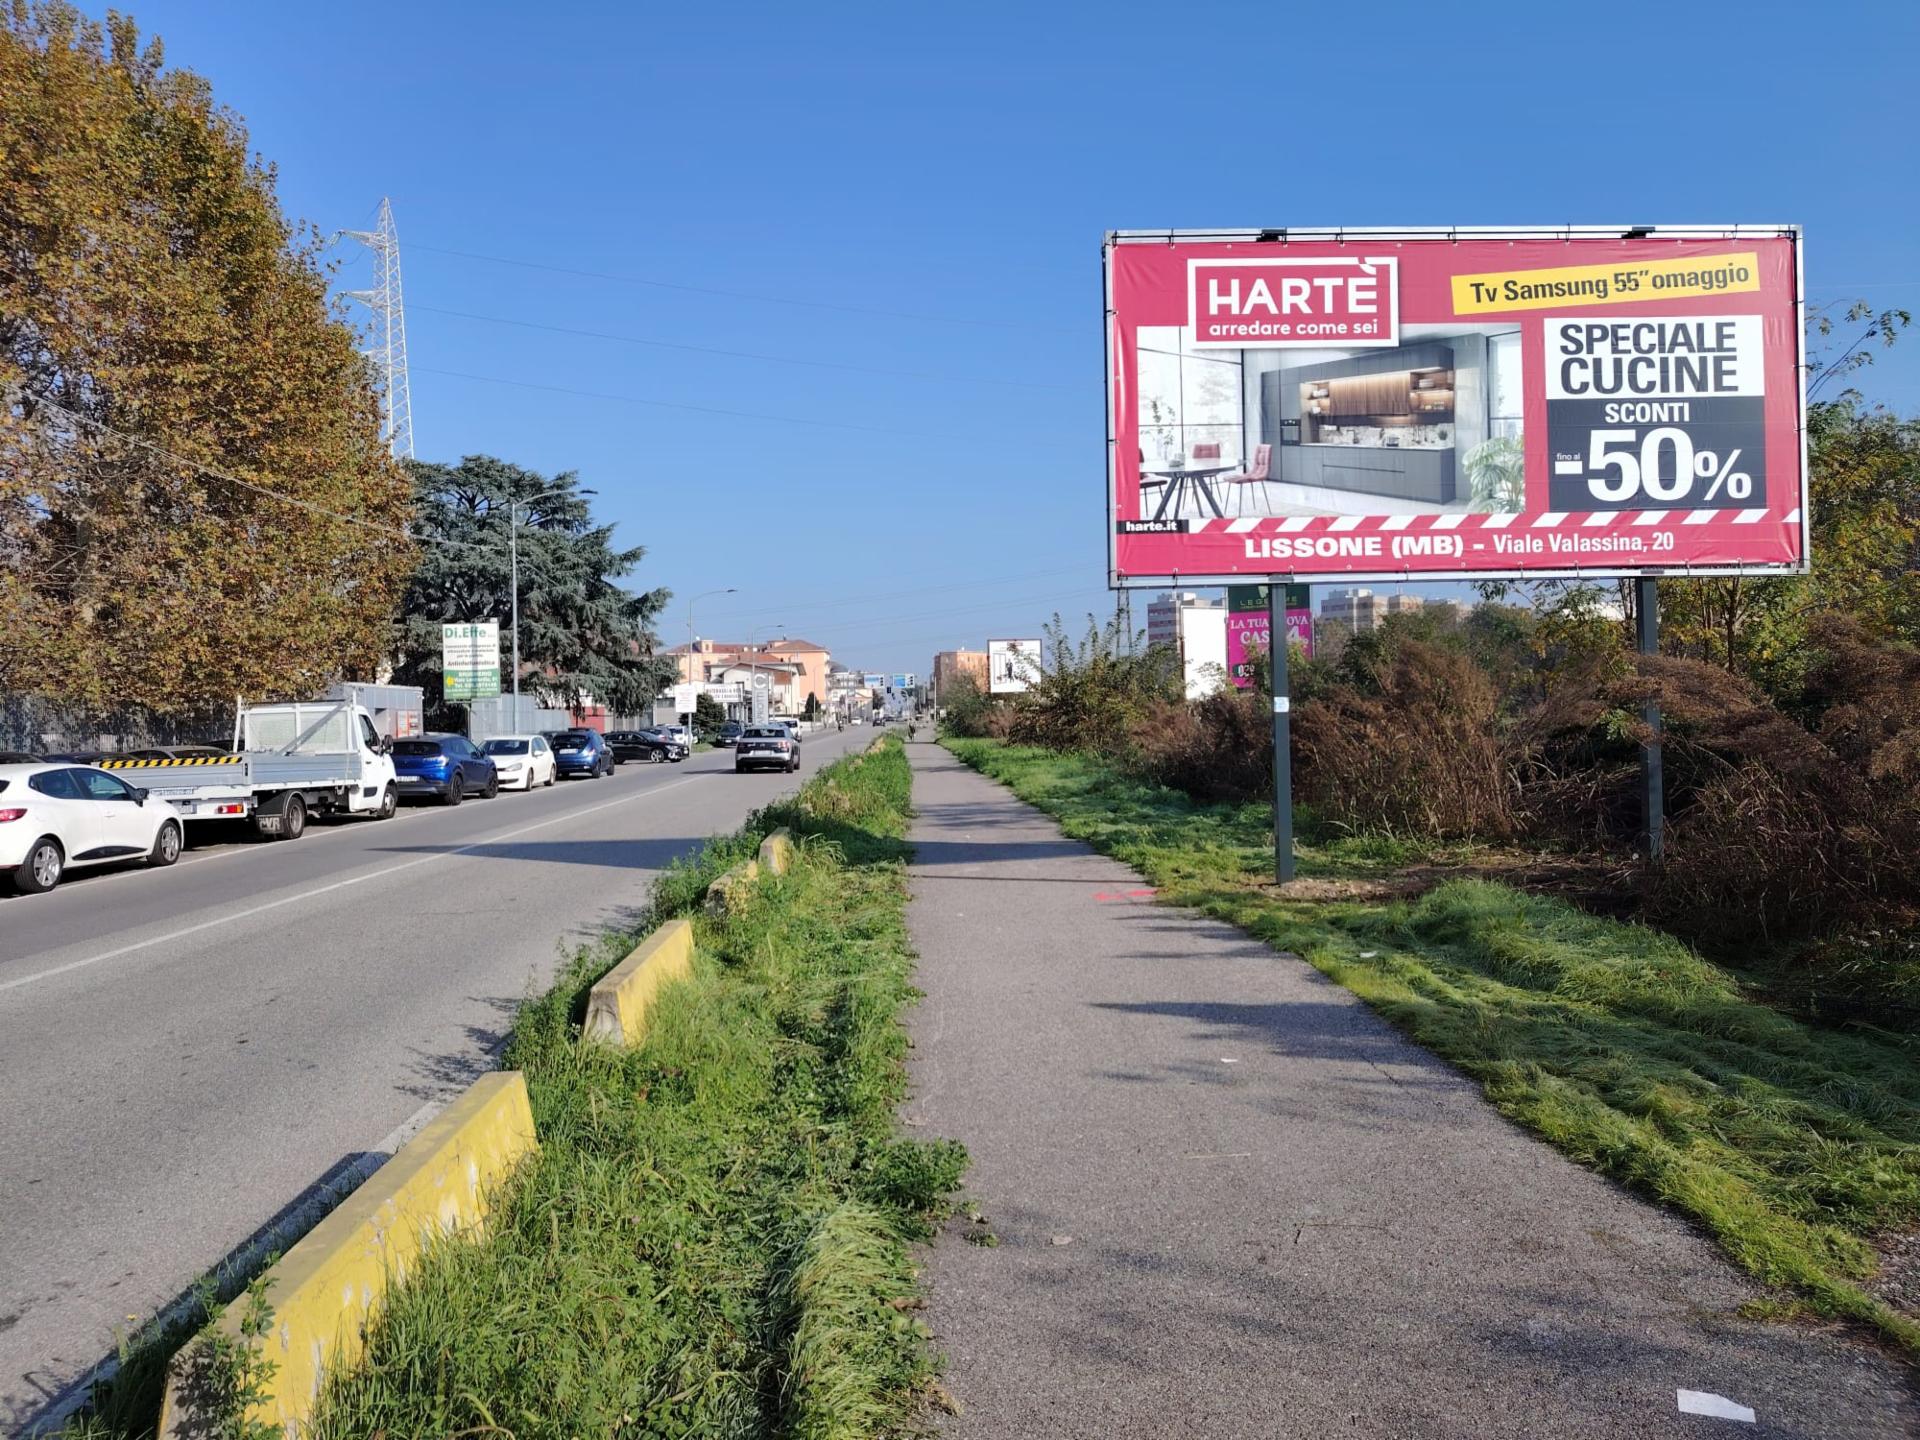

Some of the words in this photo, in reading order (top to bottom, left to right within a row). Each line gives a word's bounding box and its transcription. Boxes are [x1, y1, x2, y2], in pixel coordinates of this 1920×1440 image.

[1209, 257, 1377, 315] HARTÈ
[1470, 283, 1497, 303] Tv
[1504, 274, 1608, 301] Samsung
[1651, 262, 1749, 290] omaggio
[1209, 321, 1291, 336] arredare
[1297, 321, 1347, 335] come
[1353, 319, 1378, 334] sei
[1559, 322, 1738, 355] SPECIALE
[1560, 355, 1739, 395] CUCINE
[1604, 402, 1690, 423] SCONTI
[1555, 427, 1752, 502] -50%
[1557, 453, 1572, 461] fino
[1573, 452, 1580, 460] al
[1126, 521, 1177, 532] harte.it
[1245, 536, 1382, 558] LISSONE
[1392, 535, 1463, 560] (MB)
[1492, 534, 1544, 554] Viale
[1549, 532, 1648, 553] Valassina,
[1652, 532, 1674, 550] 20
[1231, 620, 1245, 629] LA
[1247, 618, 1269, 628] TUA
